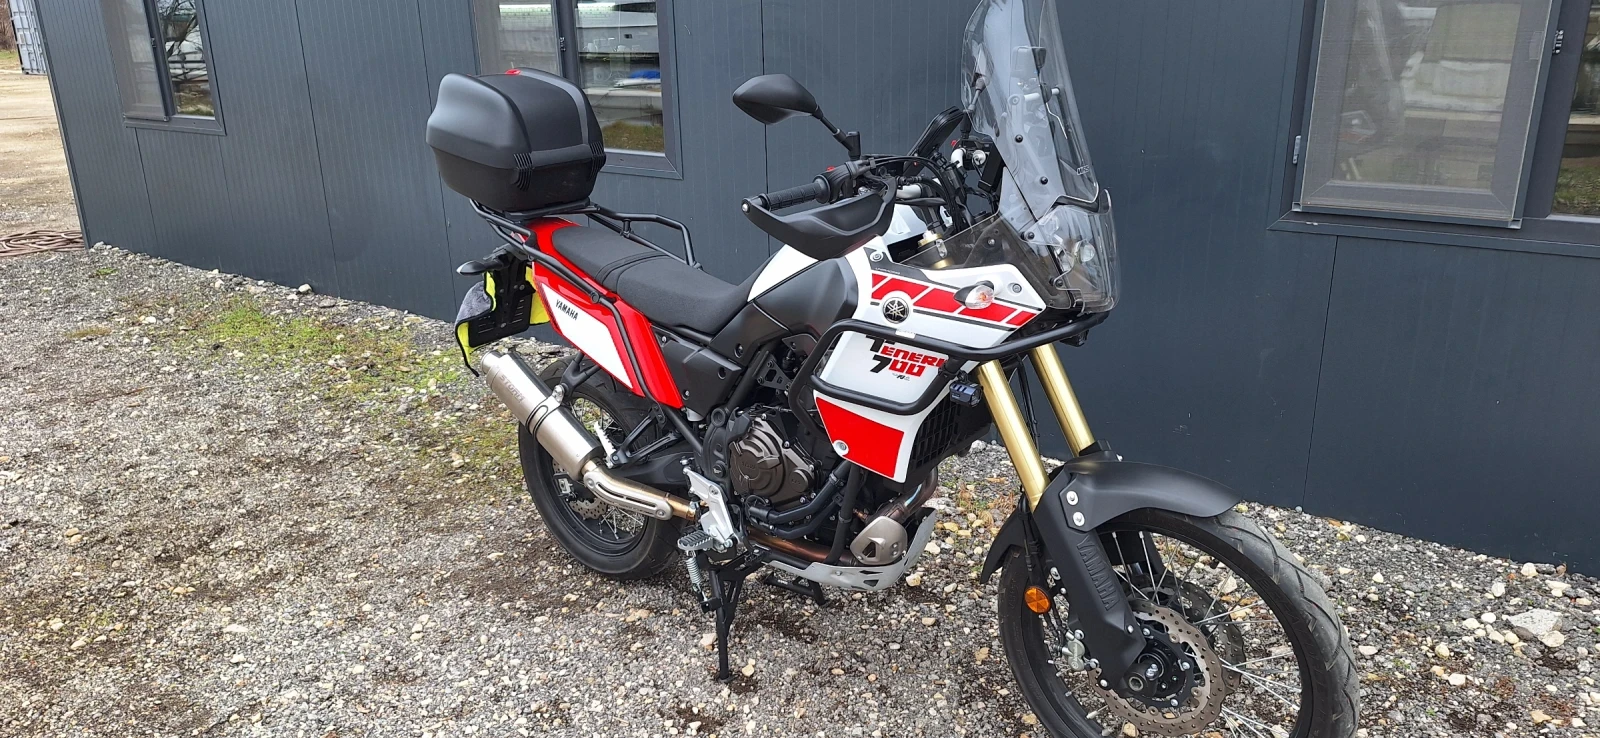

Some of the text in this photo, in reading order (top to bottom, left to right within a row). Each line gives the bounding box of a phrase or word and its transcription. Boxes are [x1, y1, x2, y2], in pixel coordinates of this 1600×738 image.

[555, 299, 579, 321] YAMAHA
[870, 354, 926, 377] 700
[1076, 534, 1120, 612] YAMAHA
